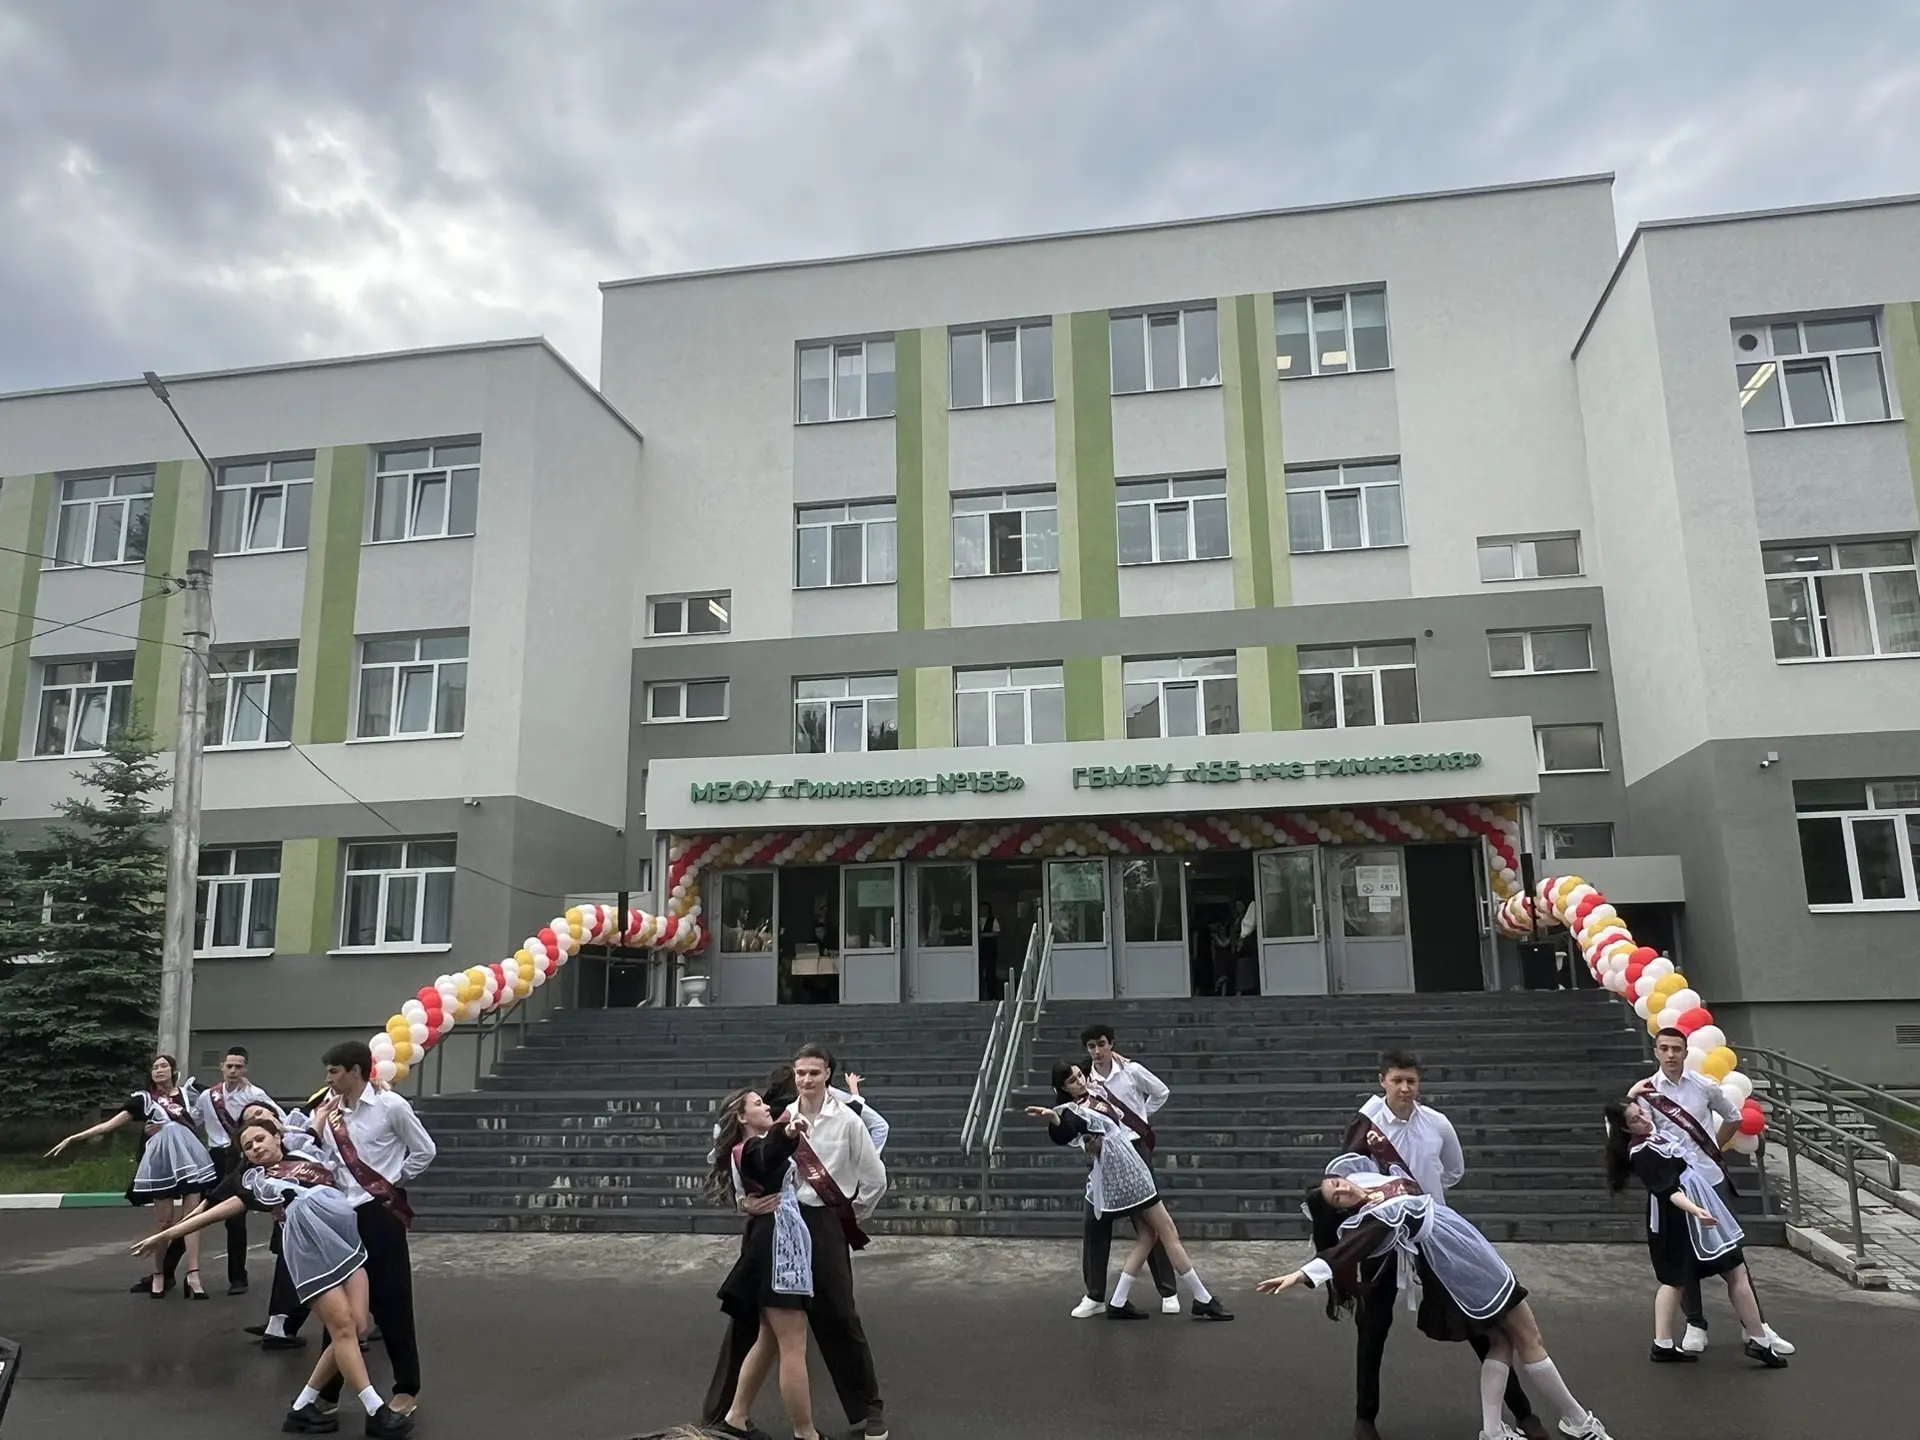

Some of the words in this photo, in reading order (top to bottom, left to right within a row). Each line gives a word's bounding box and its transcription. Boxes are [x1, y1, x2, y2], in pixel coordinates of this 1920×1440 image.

[691, 780, 772, 804] МБОУ
[779, 778, 928, 799] «Гимназия
[936, 771, 1025, 795] №155»
[1072, 762, 1172, 789] ГБМБУ
[1183, 760, 1241, 783] «155
[1250, 761, 1304, 781] нче
[1315, 752, 1482, 778] гимназия»
